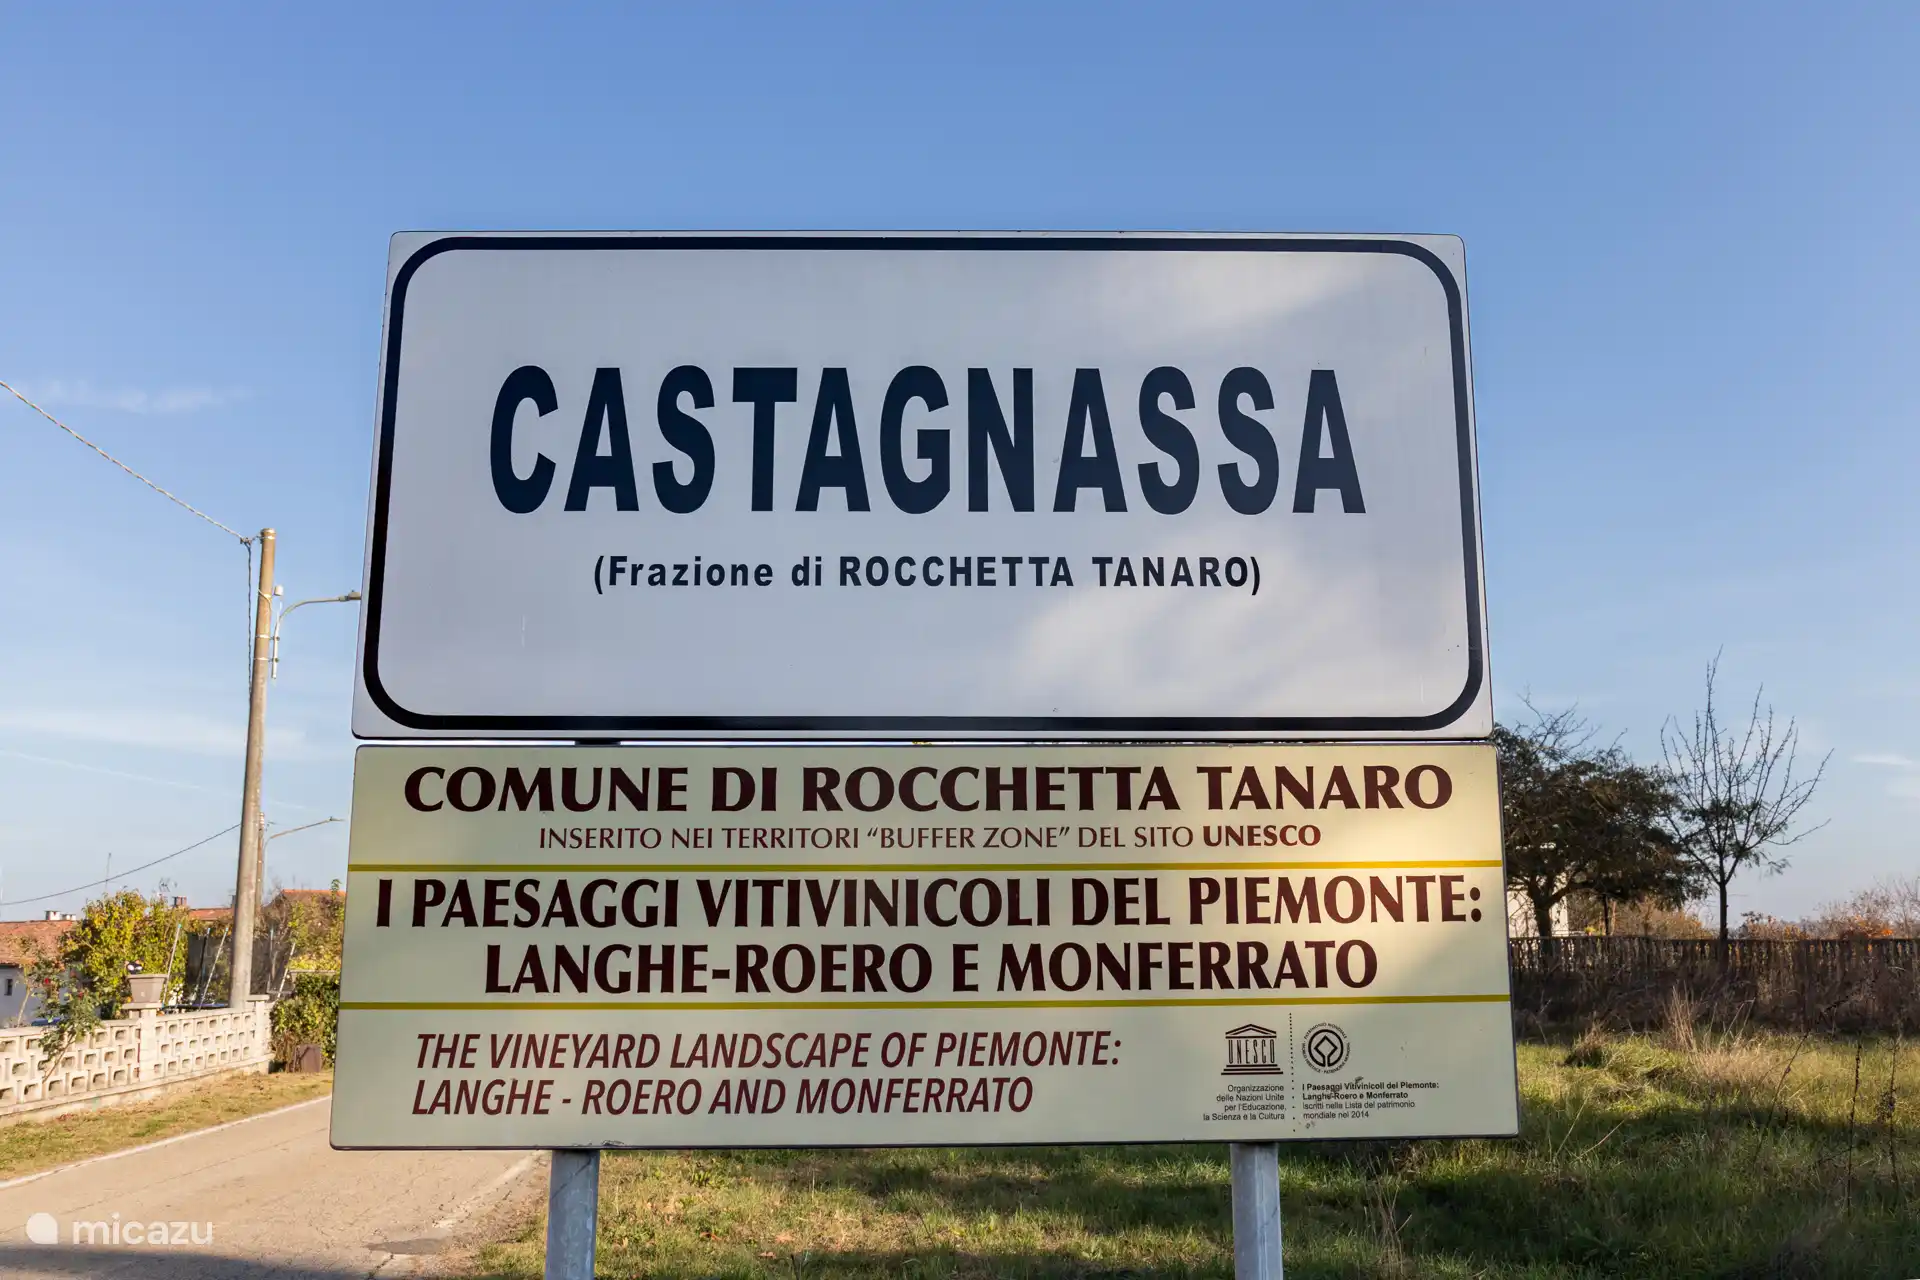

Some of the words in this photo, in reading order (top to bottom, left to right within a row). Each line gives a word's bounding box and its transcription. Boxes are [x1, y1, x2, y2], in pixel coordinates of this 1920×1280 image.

[490, 365, 1367, 515] CASTAGNASSA
[594, 555, 774, 595] (Frazione
[791, 555, 822, 587] di
[839, 555, 1074, 587] ROCCHETTA
[1091, 556, 1261, 595] TANARO)
[405, 766, 689, 812] COMUNE
[711, 766, 778, 812] DI
[802, 765, 1181, 812] ROCCHETTA
[1197, 764, 1453, 811] TANARO
[540, 827, 662, 850] INSERITO
[671, 827, 713, 849] NEI
[721, 827, 859, 849] TERRITORI
[1078, 826, 1126, 848] DEL
[1134, 826, 1194, 848] SITO
[1203, 824, 1321, 847] UNESCO
[375, 878, 393, 928] I
[411, 878, 680, 929] PAESAGGI
[696, 877, 1051, 928] VITIVINICOLI
[1071, 877, 1171, 927] DEL
[1188, 874, 1482, 925] PIEMONTE:
[485, 943, 933, 994] LANGHE-ROERO
[952, 943, 979, 993] E
[997, 939, 1378, 992] MONFERRATO
[416, 1033, 481, 1069] THE
[490, 1033, 661, 1069] VINEYARD
[669, 1032, 873, 1069] LANDSCAPE
[880, 1031, 928, 1068] OF
[934, 1030, 1122, 1068] PIEMONTE:
[1228, 1039, 1275, 1064] UNESCO
[412, 1078, 552, 1115] LANGHE
[581, 1078, 702, 1116] ROERO
[708, 1078, 786, 1115] AND
[795, 1076, 1034, 1115] MONFERRATO
[1216, 1094, 1234, 1102] delle
[1235, 1093, 1263, 1101] Nazioni
[1265, 1092, 1285, 1101] Unite
[1227, 1083, 1285, 1093] Organizzazione
[1302, 1092, 1357, 1102] Langhe-Roero
[1366, 1091, 1409, 1100] Monferrato
[1306, 1082, 1342, 1093] Paesaggi
[1344, 1081, 1385, 1091] Vitivinicoli
[1386, 1081, 1399, 1089] del
[1400, 1080, 1440, 1089] Piemonte:
[1203, 1113, 1210, 1121] la
[1212, 1112, 1241, 1121] Scienza
[1249, 1112, 1257, 1120] la
[1258, 1111, 1285, 1120] Cultura
[1224, 1104, 1237, 1112] per
[1303, 1110, 1336, 1120] mondiale
[1338, 1110, 1349, 1118] nel
[1351, 1110, 1369, 1118] 2014
[1325, 1101, 1343, 1109] nella
[1345, 1101, 1362, 1109] Lista
[1364, 1100, 1376, 1108] del
[1377, 1099, 1415, 1110] patrimonio
